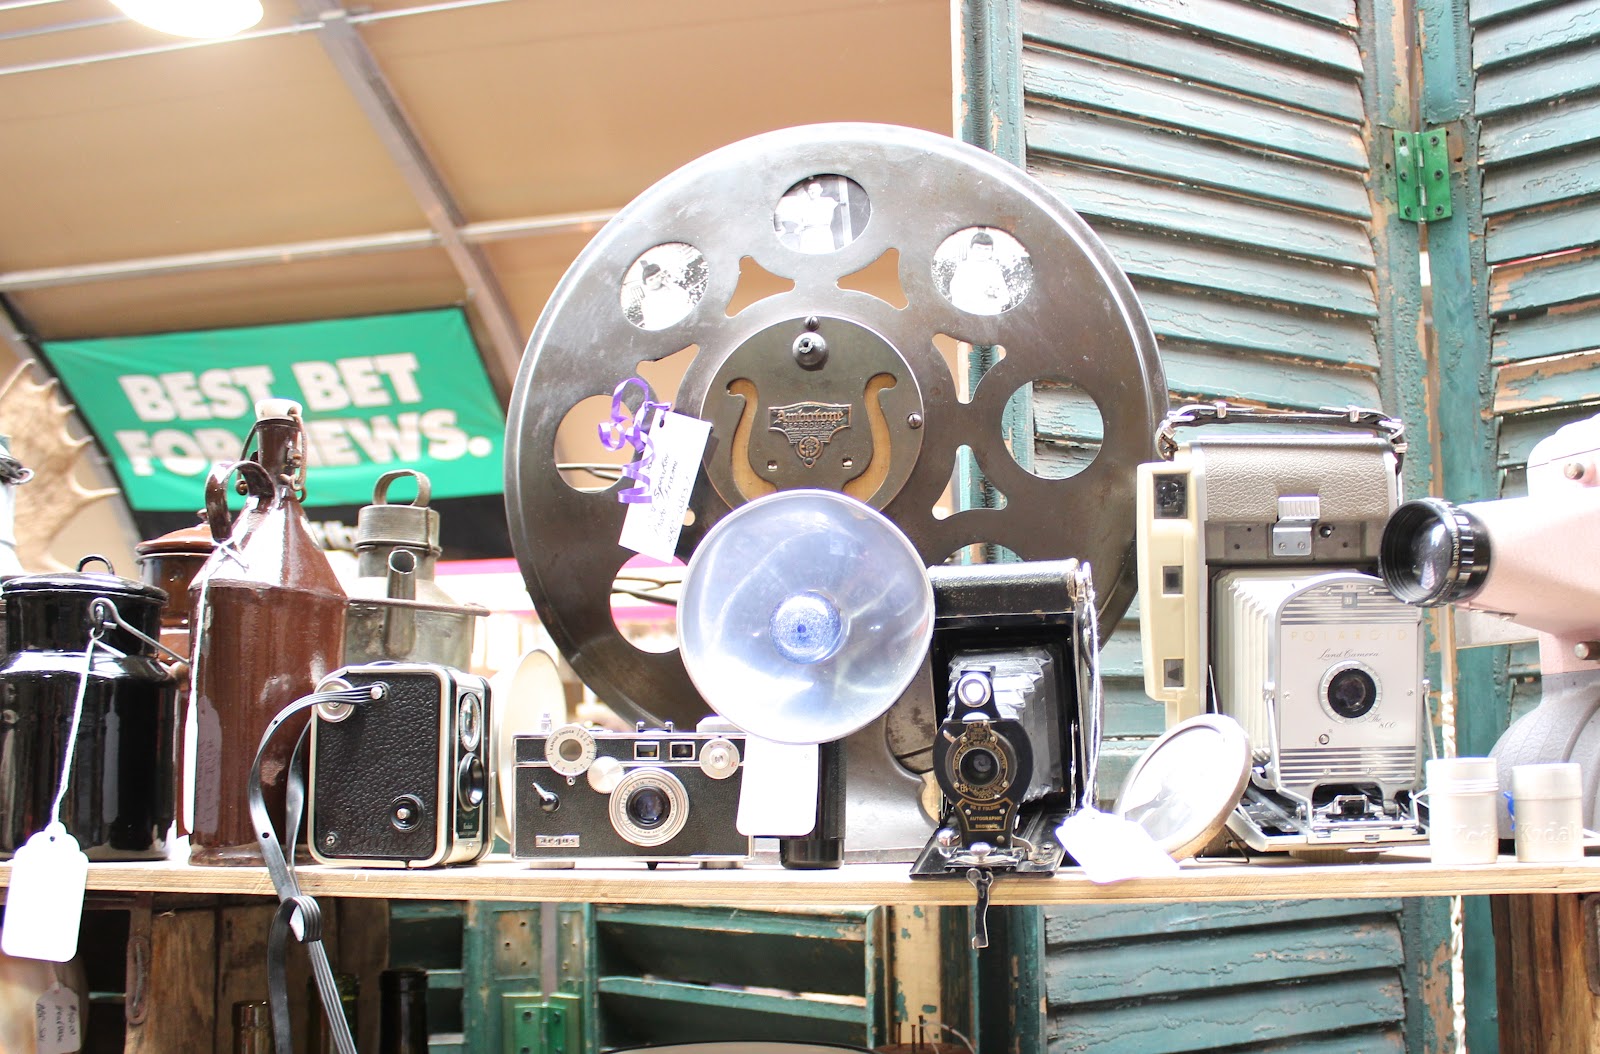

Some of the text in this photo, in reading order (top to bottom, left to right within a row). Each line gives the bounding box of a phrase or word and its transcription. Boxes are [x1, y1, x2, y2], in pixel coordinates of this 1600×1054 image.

[119, 352, 421, 422] BEST BET
[1318, 648, 1380, 661] Land Camera
